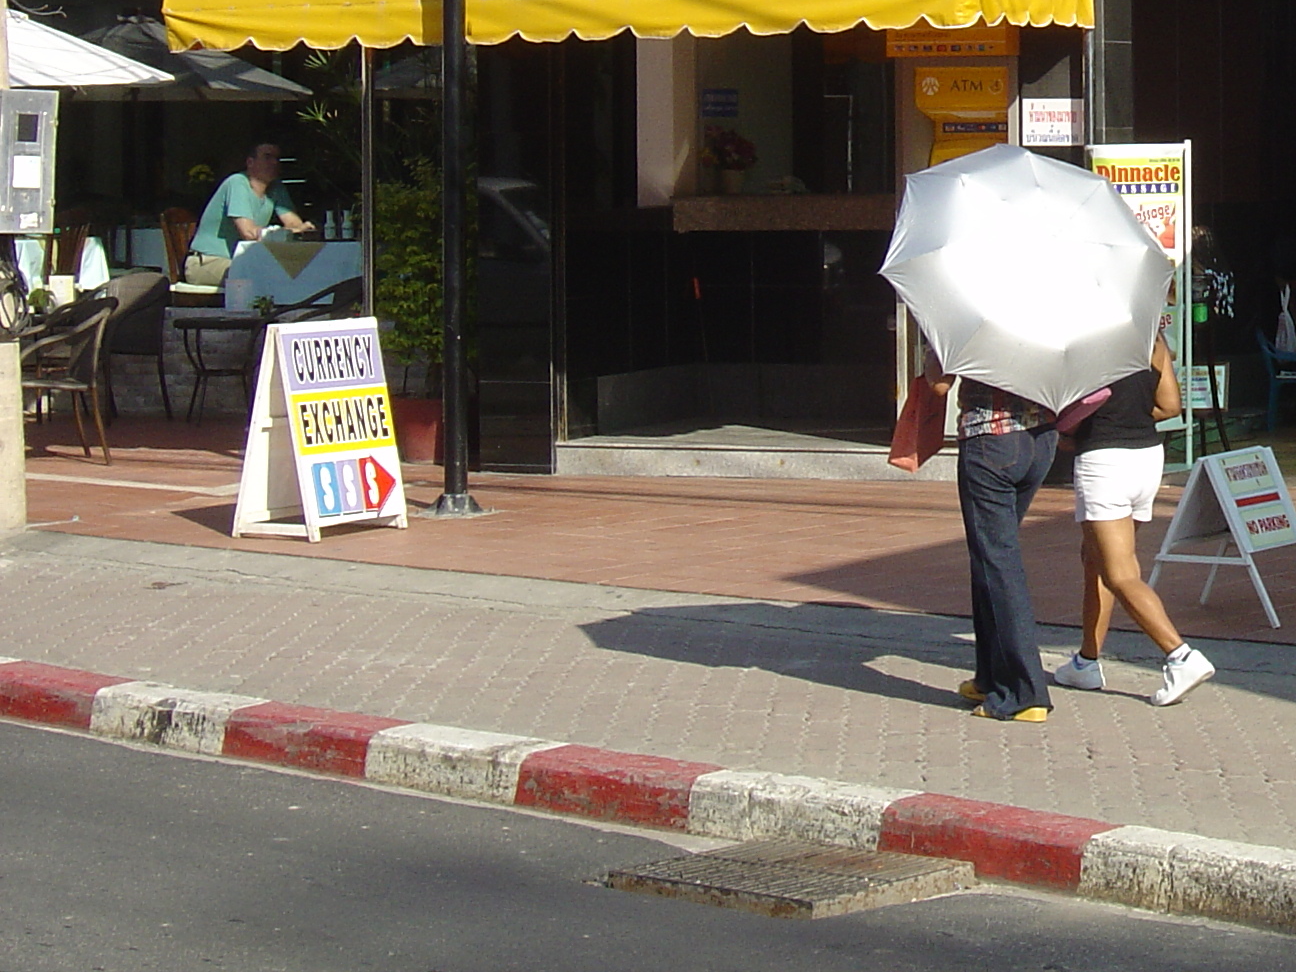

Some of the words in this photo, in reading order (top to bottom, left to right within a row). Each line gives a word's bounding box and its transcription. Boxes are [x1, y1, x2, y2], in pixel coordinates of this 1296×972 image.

[950, 79, 984, 91] ATM
[292, 336, 375, 383] CURRENCY
[299, 396, 390, 446] EXCHANGE
[1246, 520, 1259, 534] NO
[1258, 514, 1290, 533] PARKING
